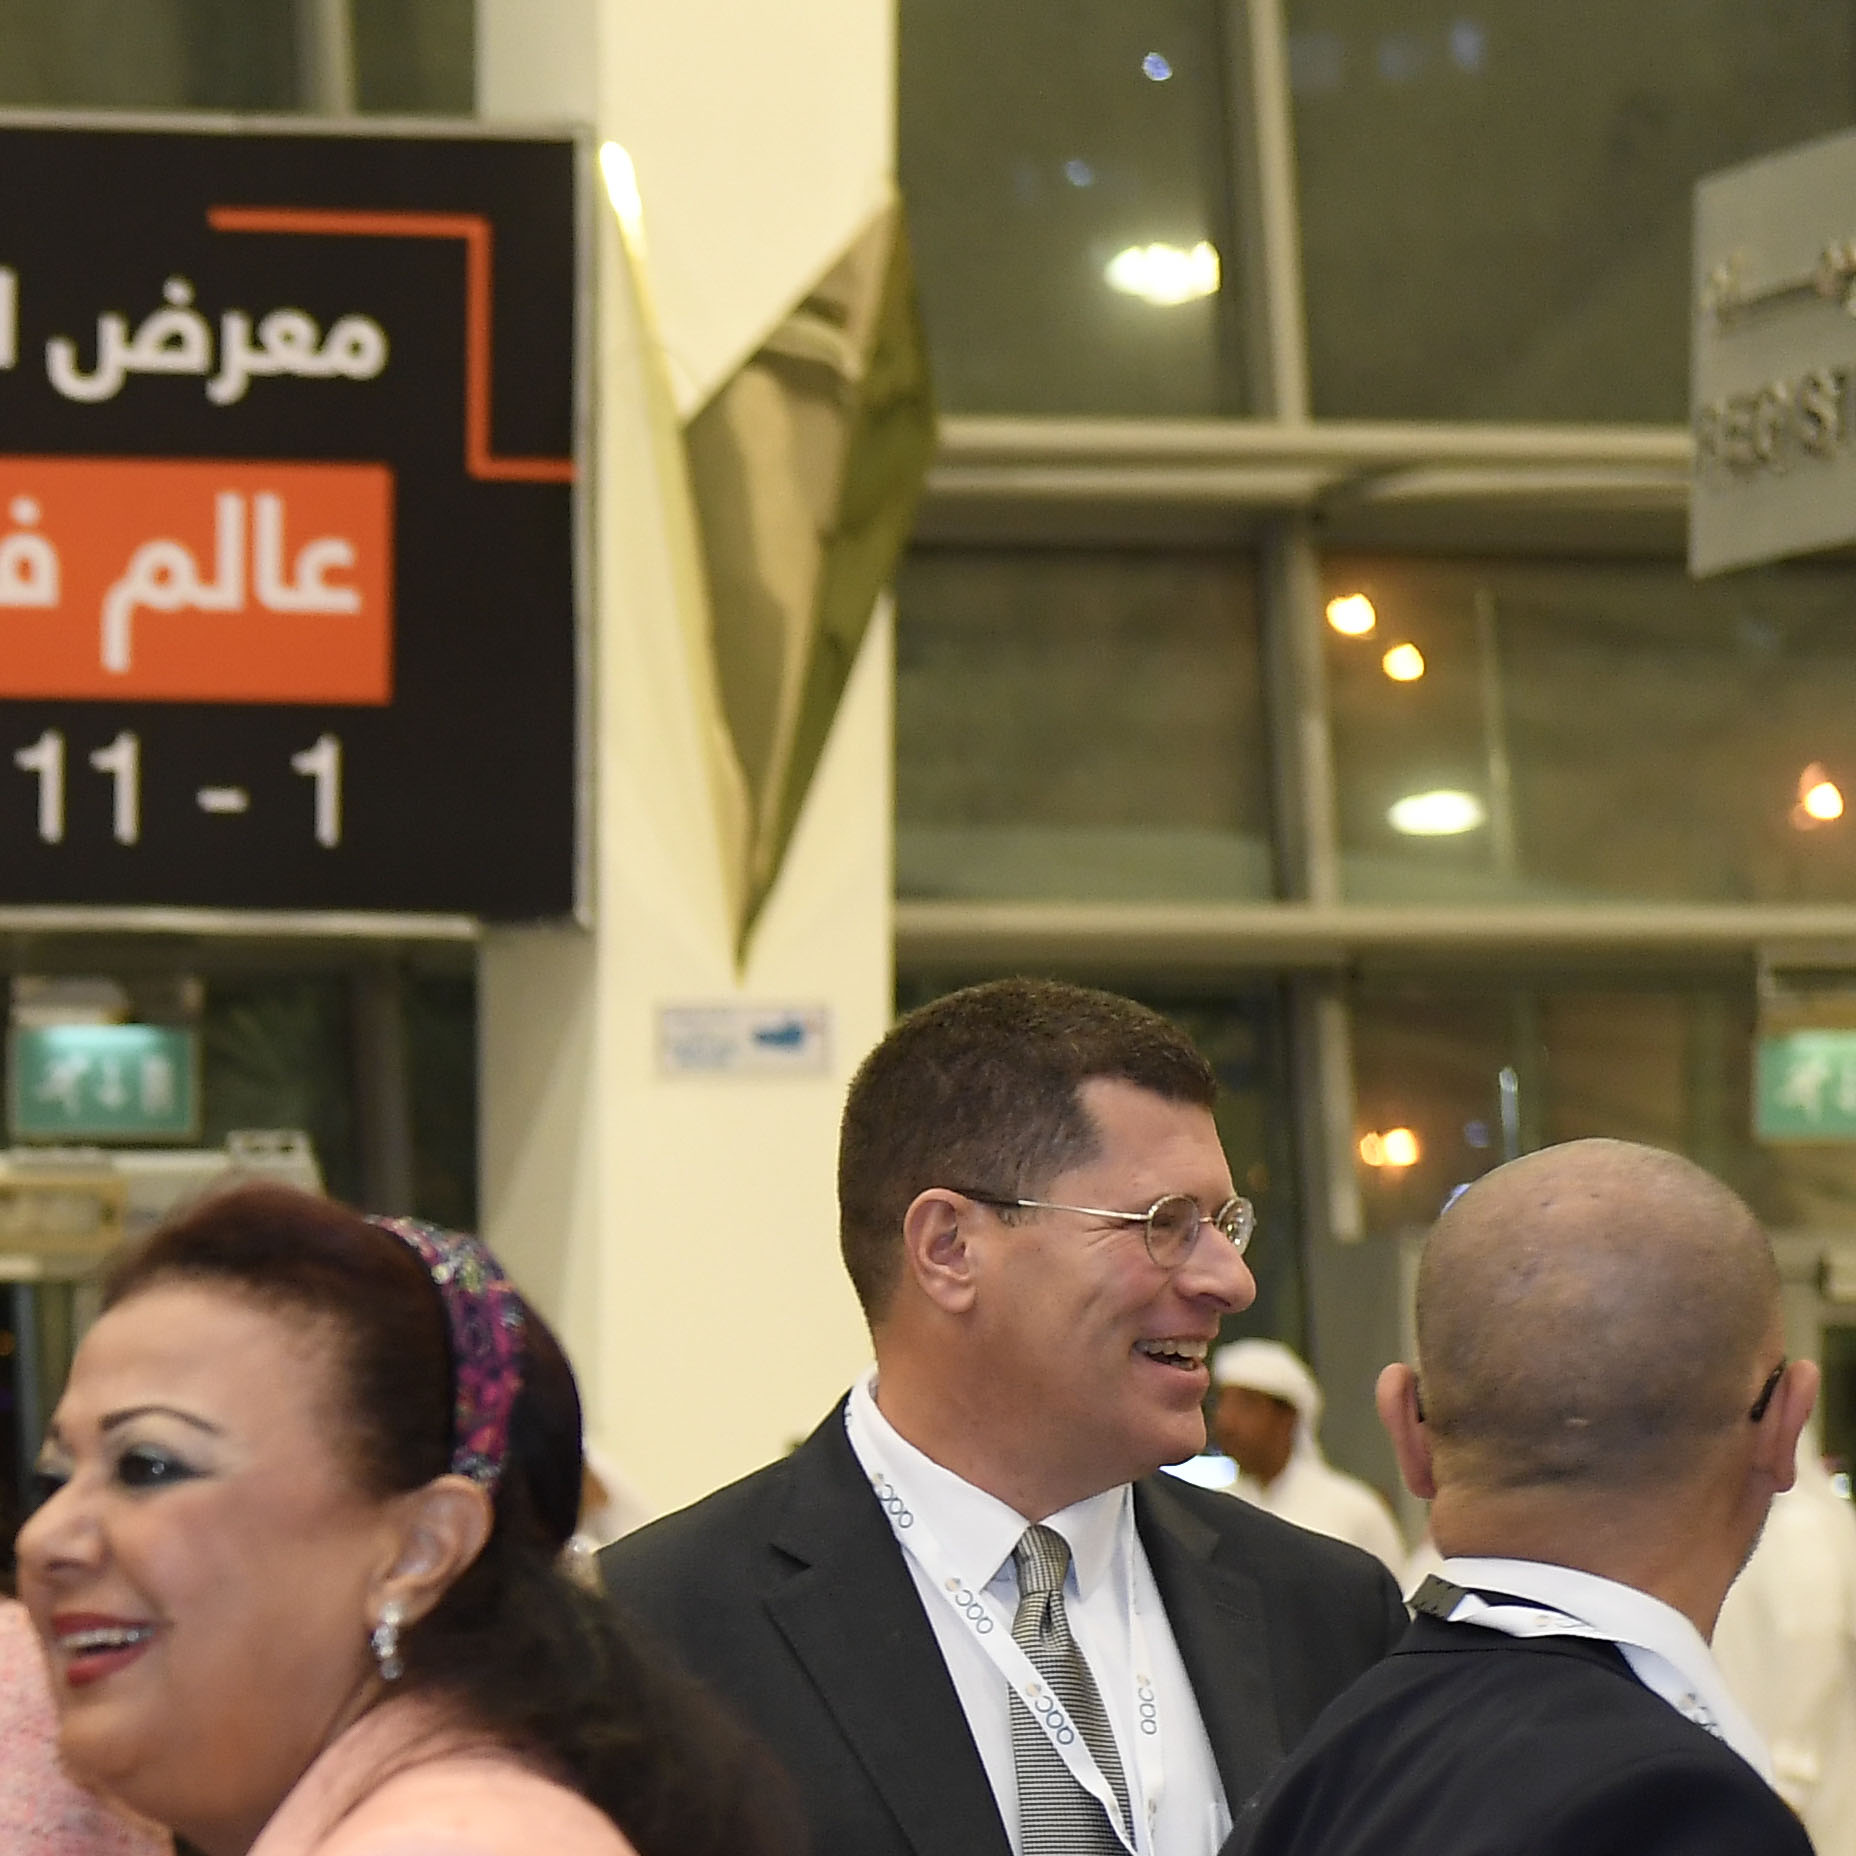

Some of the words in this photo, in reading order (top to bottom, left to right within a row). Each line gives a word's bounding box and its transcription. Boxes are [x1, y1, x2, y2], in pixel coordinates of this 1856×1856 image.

[44, 281, 385, 404] معرض
[100, 491, 361, 673] عالم
[16, 732, 138, 843] 11
[292, 737, 338, 846] 1
